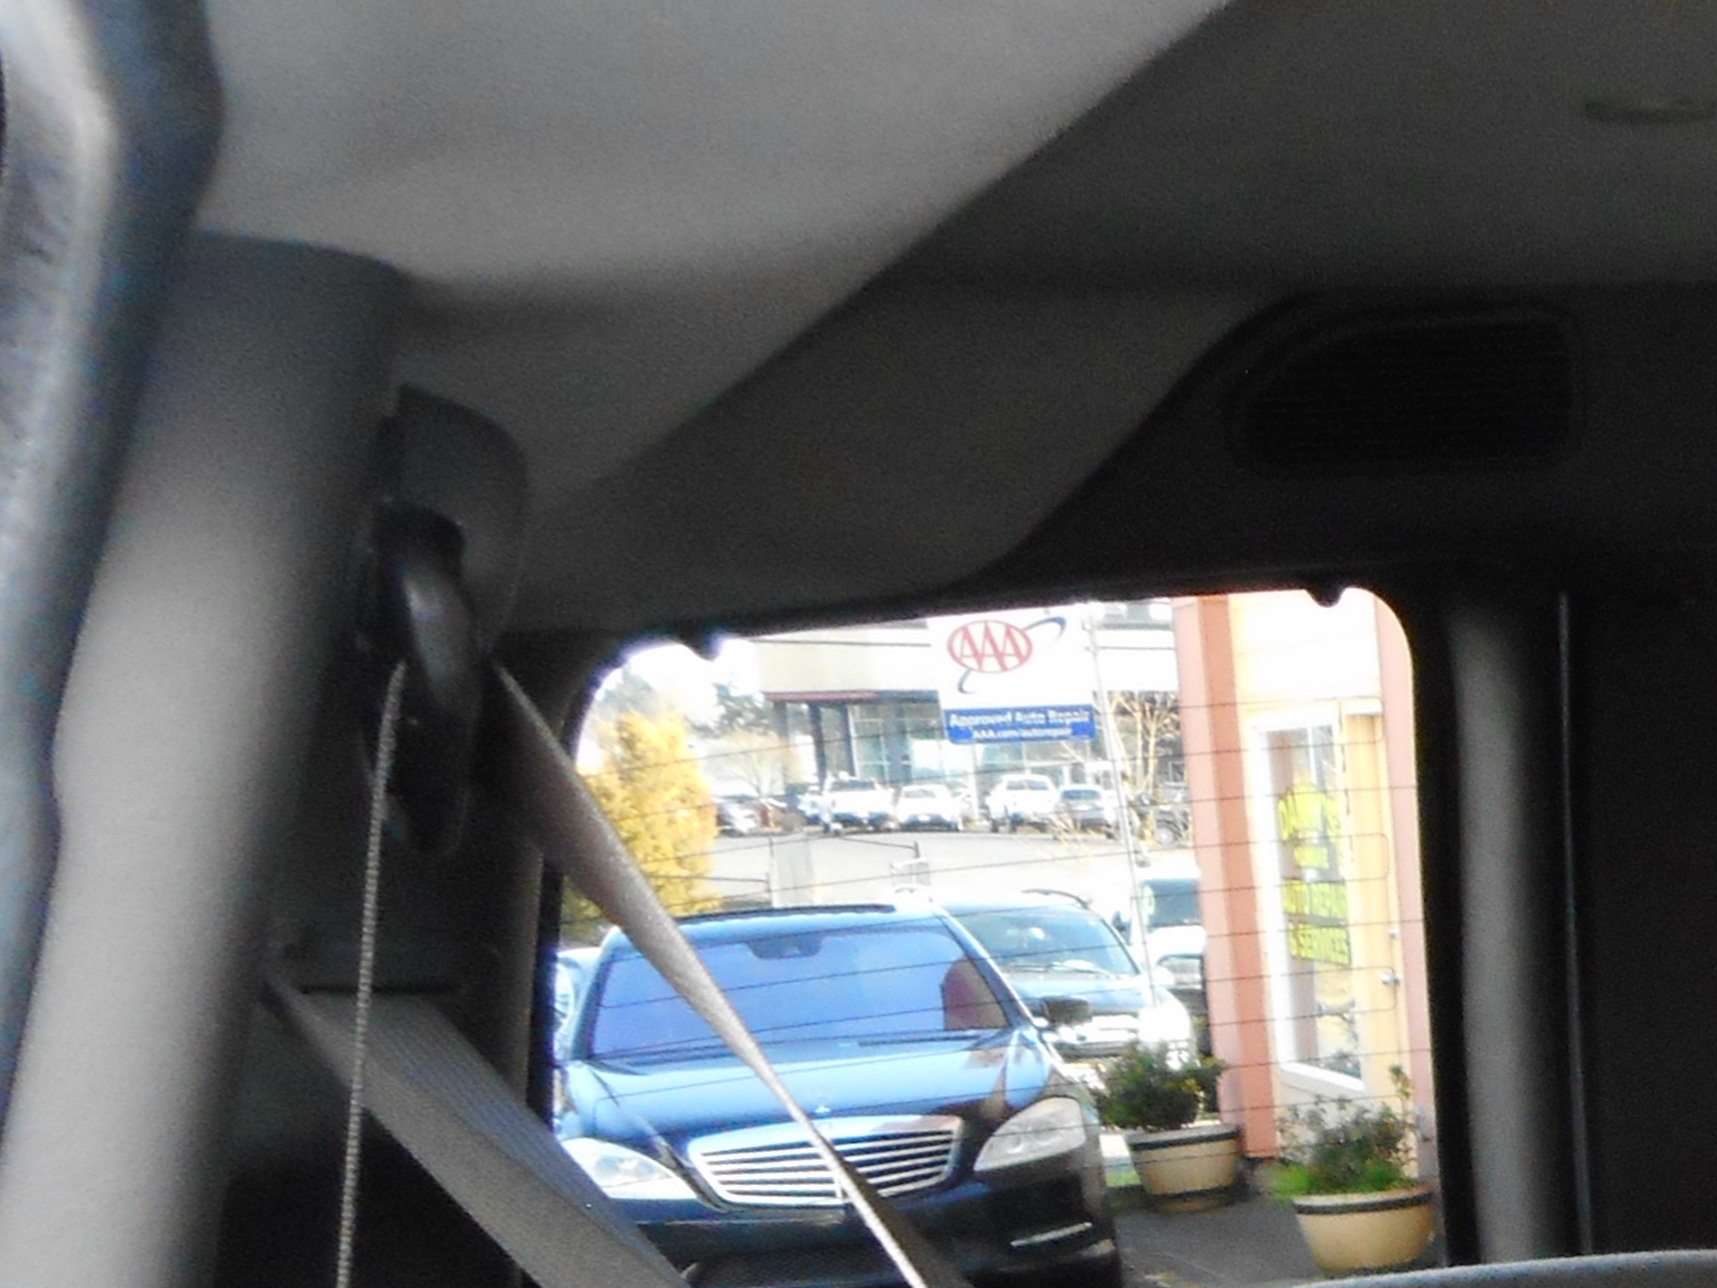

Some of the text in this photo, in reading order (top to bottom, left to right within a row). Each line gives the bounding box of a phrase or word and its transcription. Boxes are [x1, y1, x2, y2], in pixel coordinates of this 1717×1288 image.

[949, 620, 1032, 673] AAA
[950, 707, 1090, 728] Approved Auto Repair
